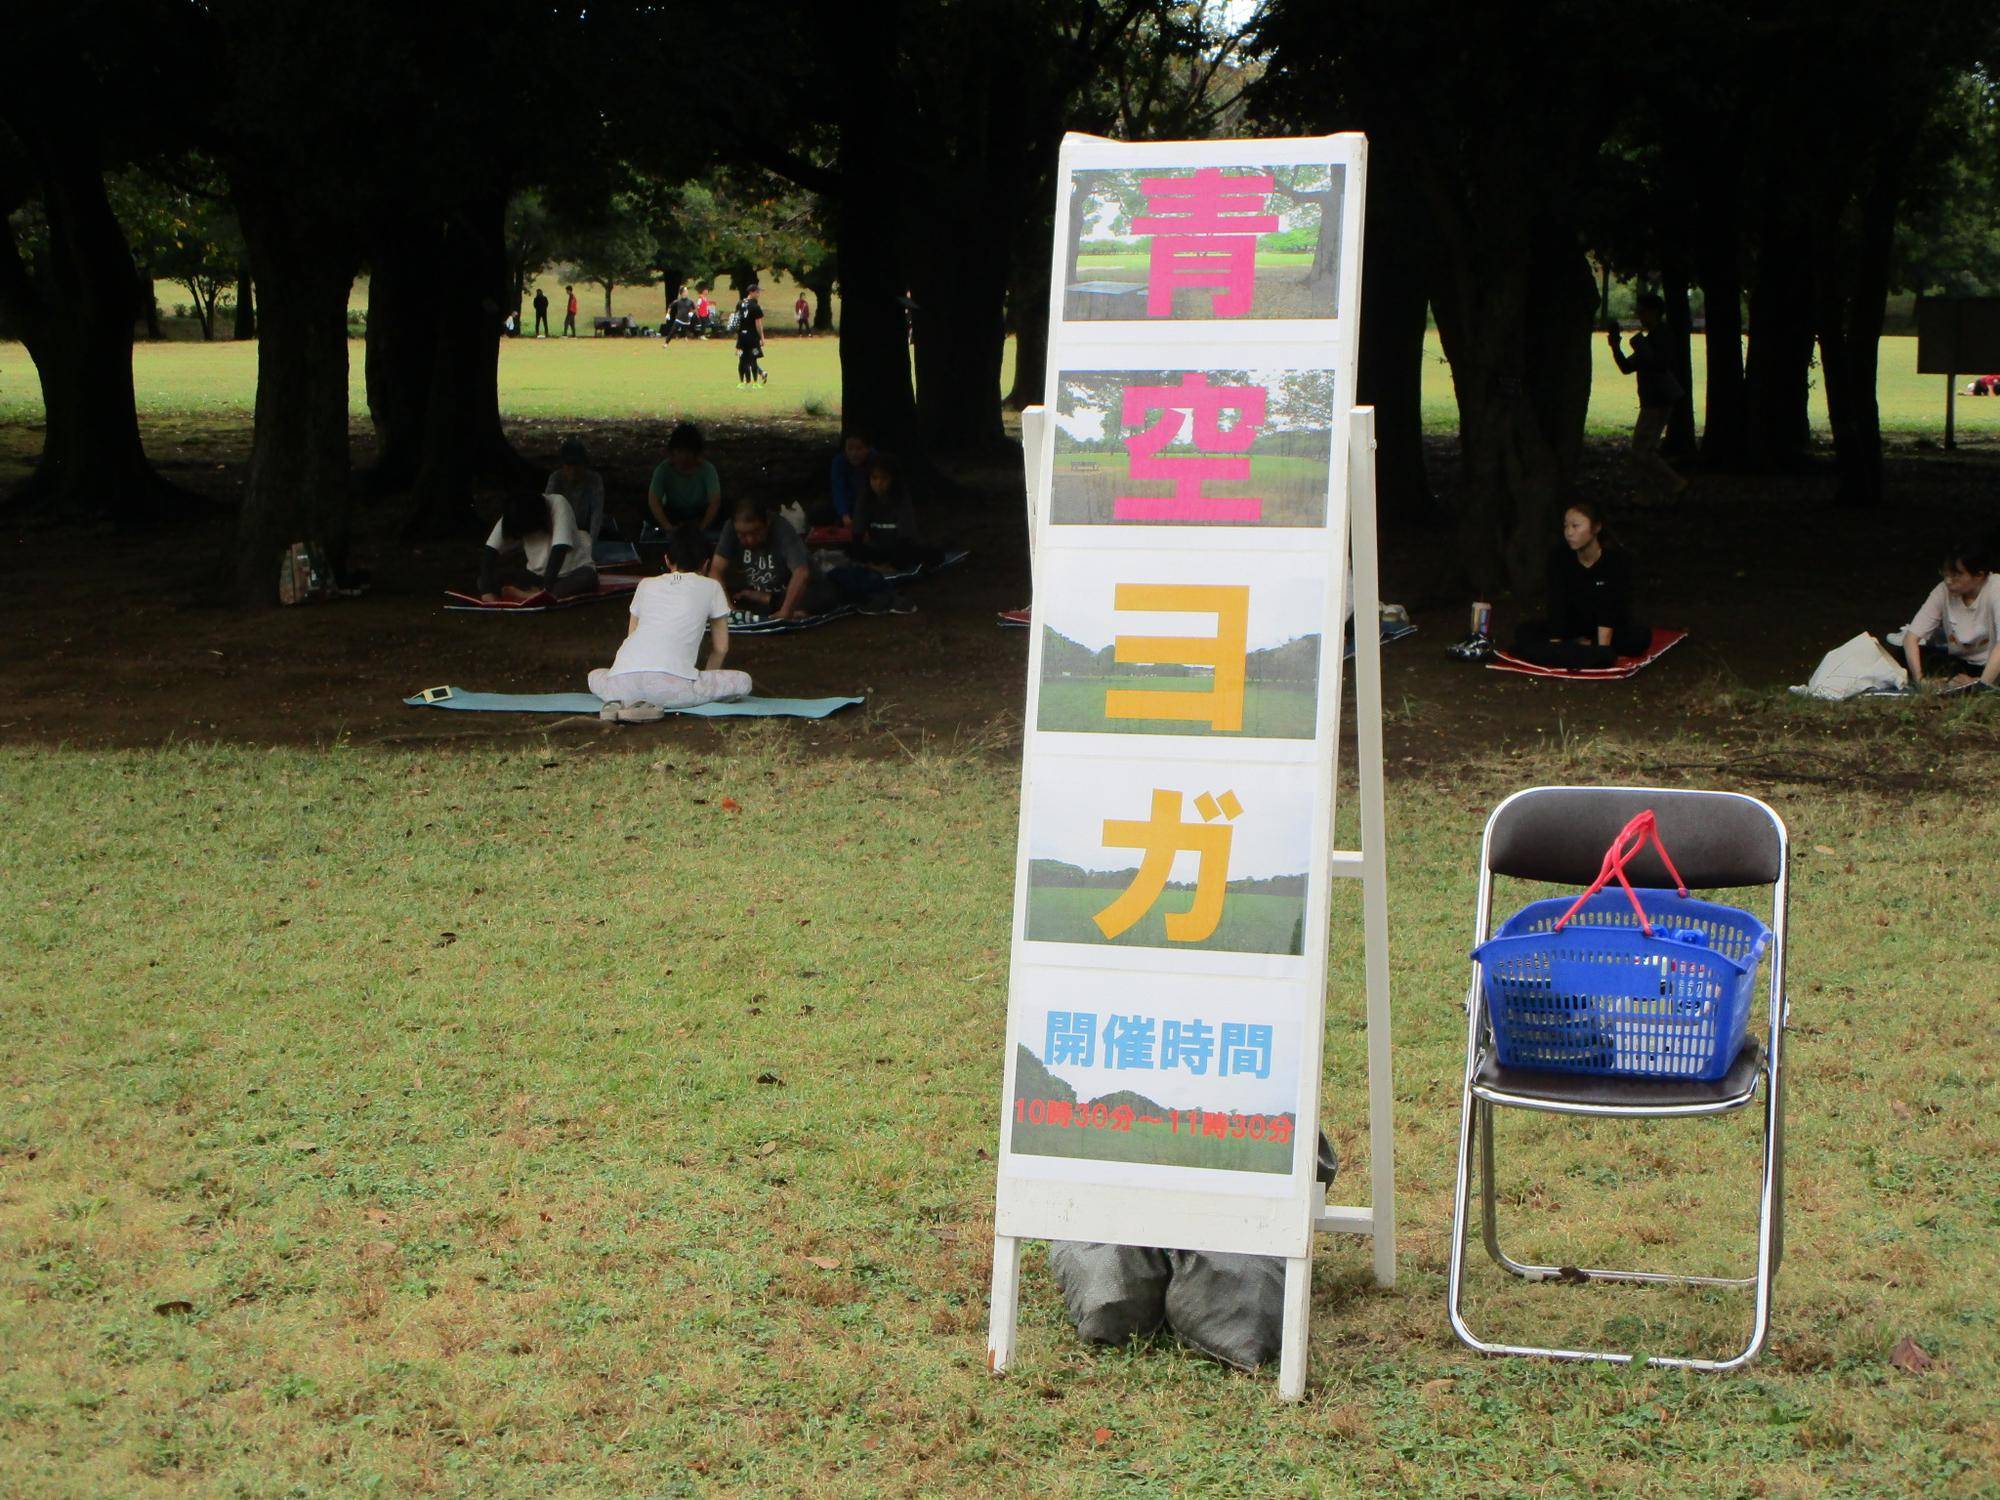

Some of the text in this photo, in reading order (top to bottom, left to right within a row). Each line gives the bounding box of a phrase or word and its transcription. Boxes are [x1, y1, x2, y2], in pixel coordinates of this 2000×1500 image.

[743, 549, 775, 570] BUE
[1043, 1010, 1273, 1079] 開催時間
